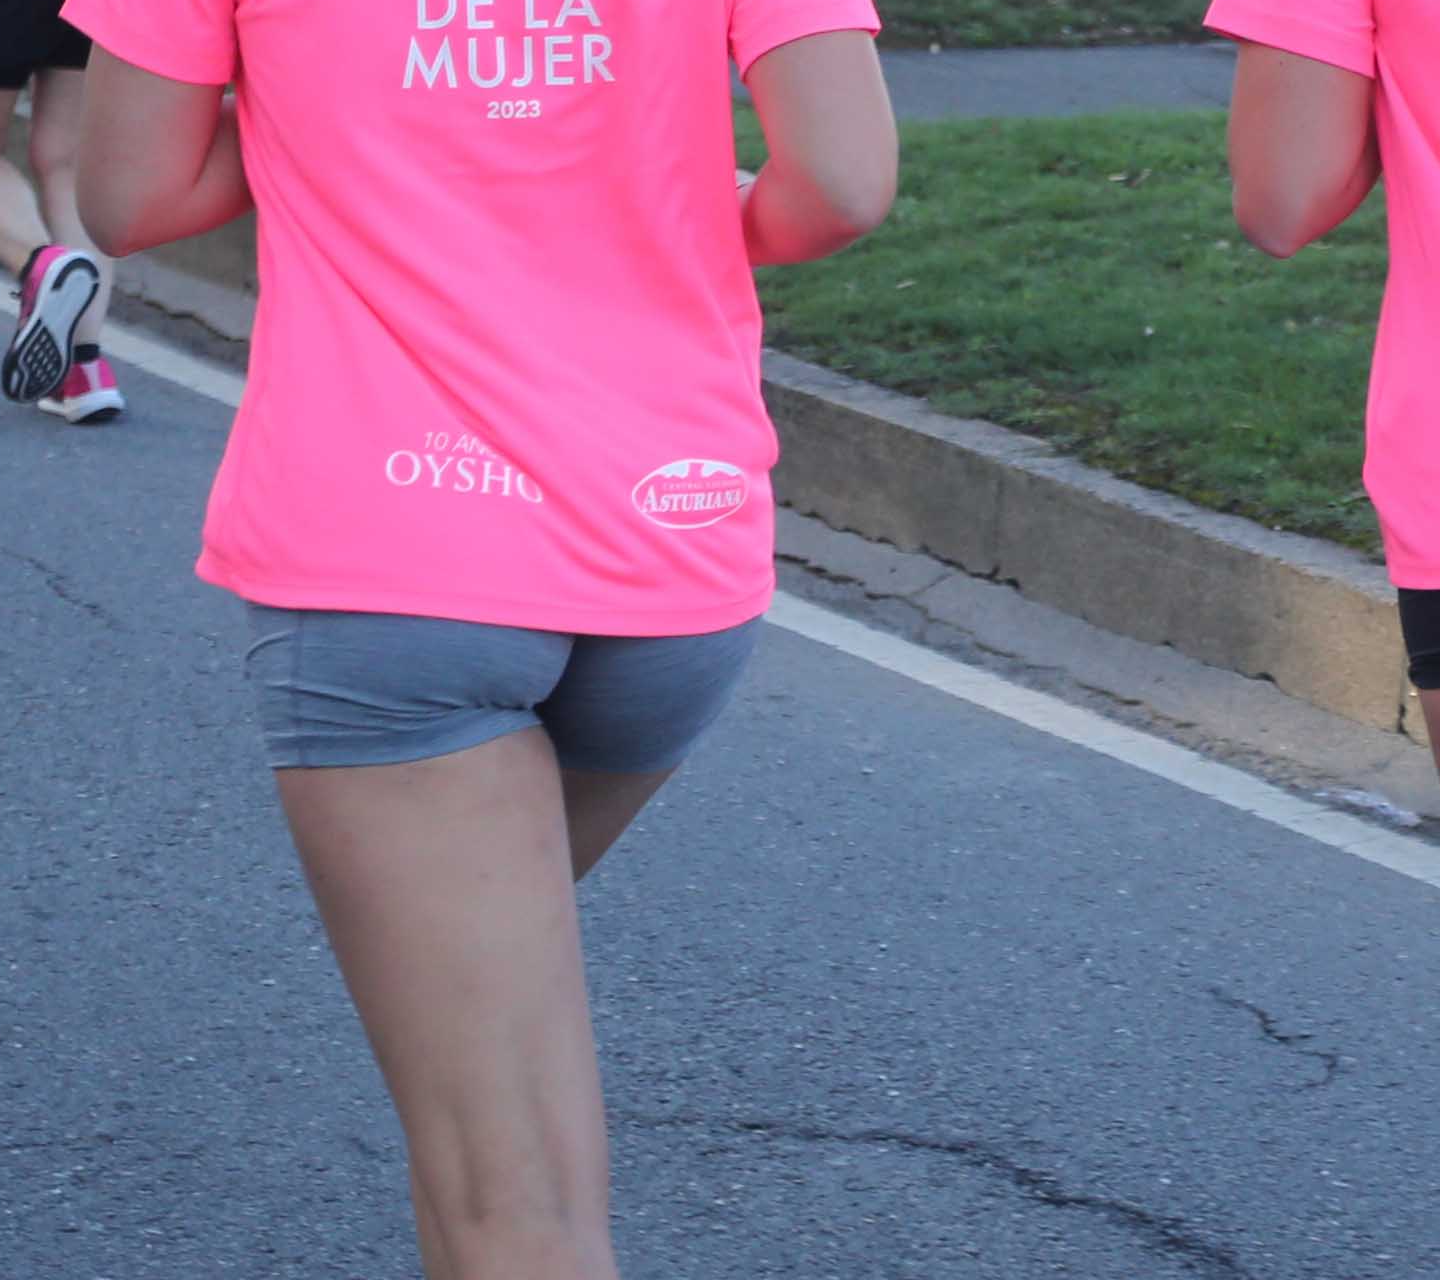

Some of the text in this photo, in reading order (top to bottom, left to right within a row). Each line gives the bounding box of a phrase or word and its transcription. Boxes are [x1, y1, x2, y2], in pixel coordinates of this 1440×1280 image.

[402, 33, 616, 90] MUJER
[486, 100, 542, 120] 2023
[424, 431, 449, 452] 10
